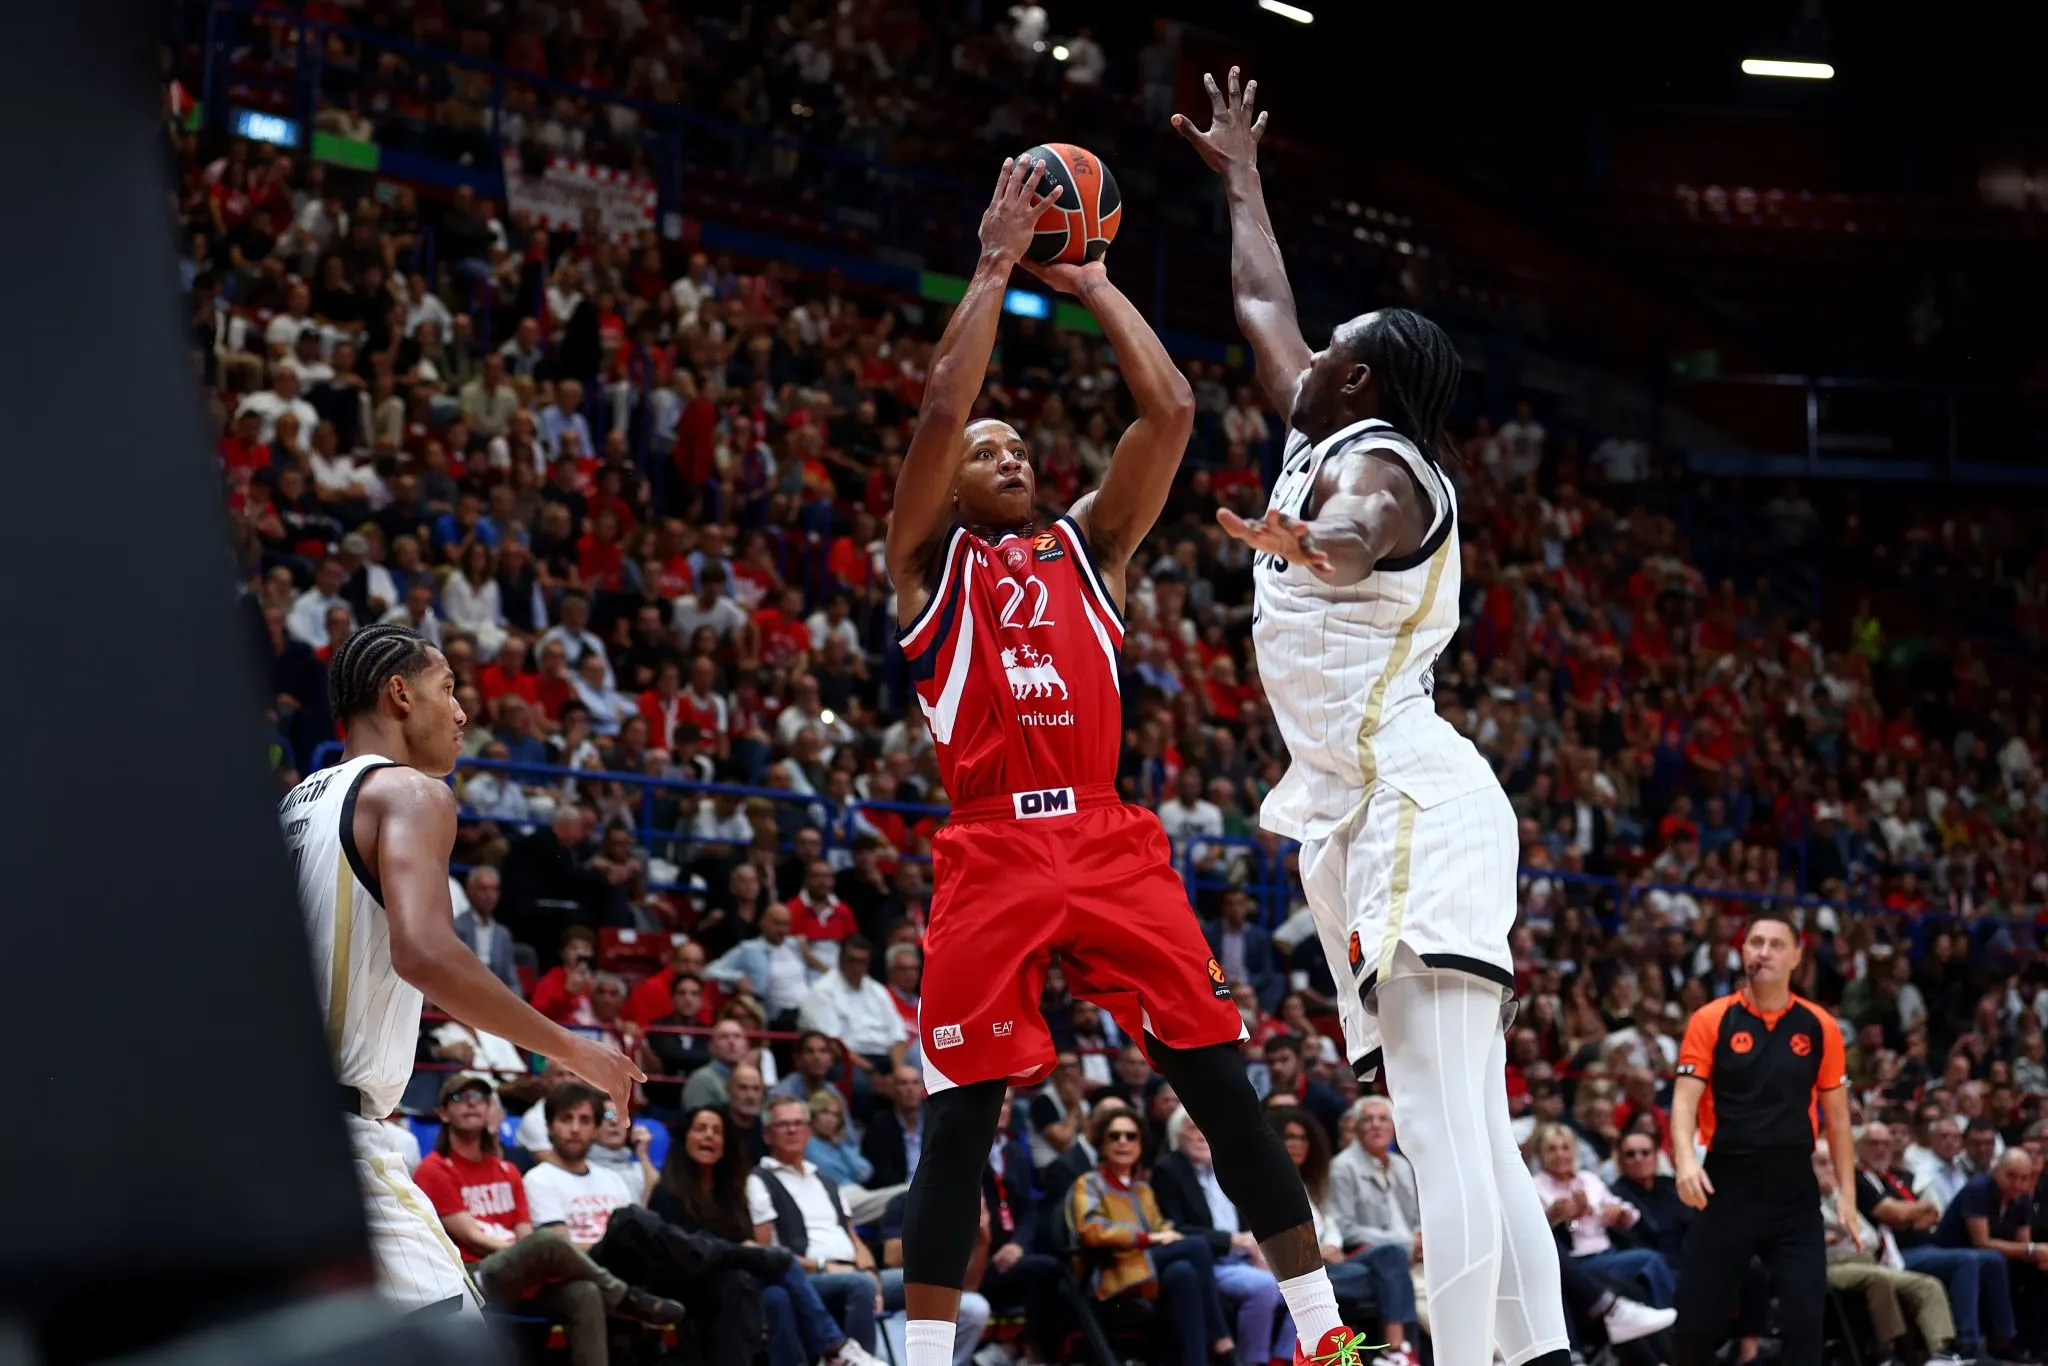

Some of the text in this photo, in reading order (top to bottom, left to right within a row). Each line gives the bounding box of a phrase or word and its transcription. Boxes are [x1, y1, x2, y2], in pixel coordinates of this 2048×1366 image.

[995, 574, 1056, 630] 22
[1017, 710, 1074, 726] nitud
[1020, 789, 1069, 815] OM
[935, 1027, 957, 1039] EA7
[992, 1020, 1014, 1034] EA7
